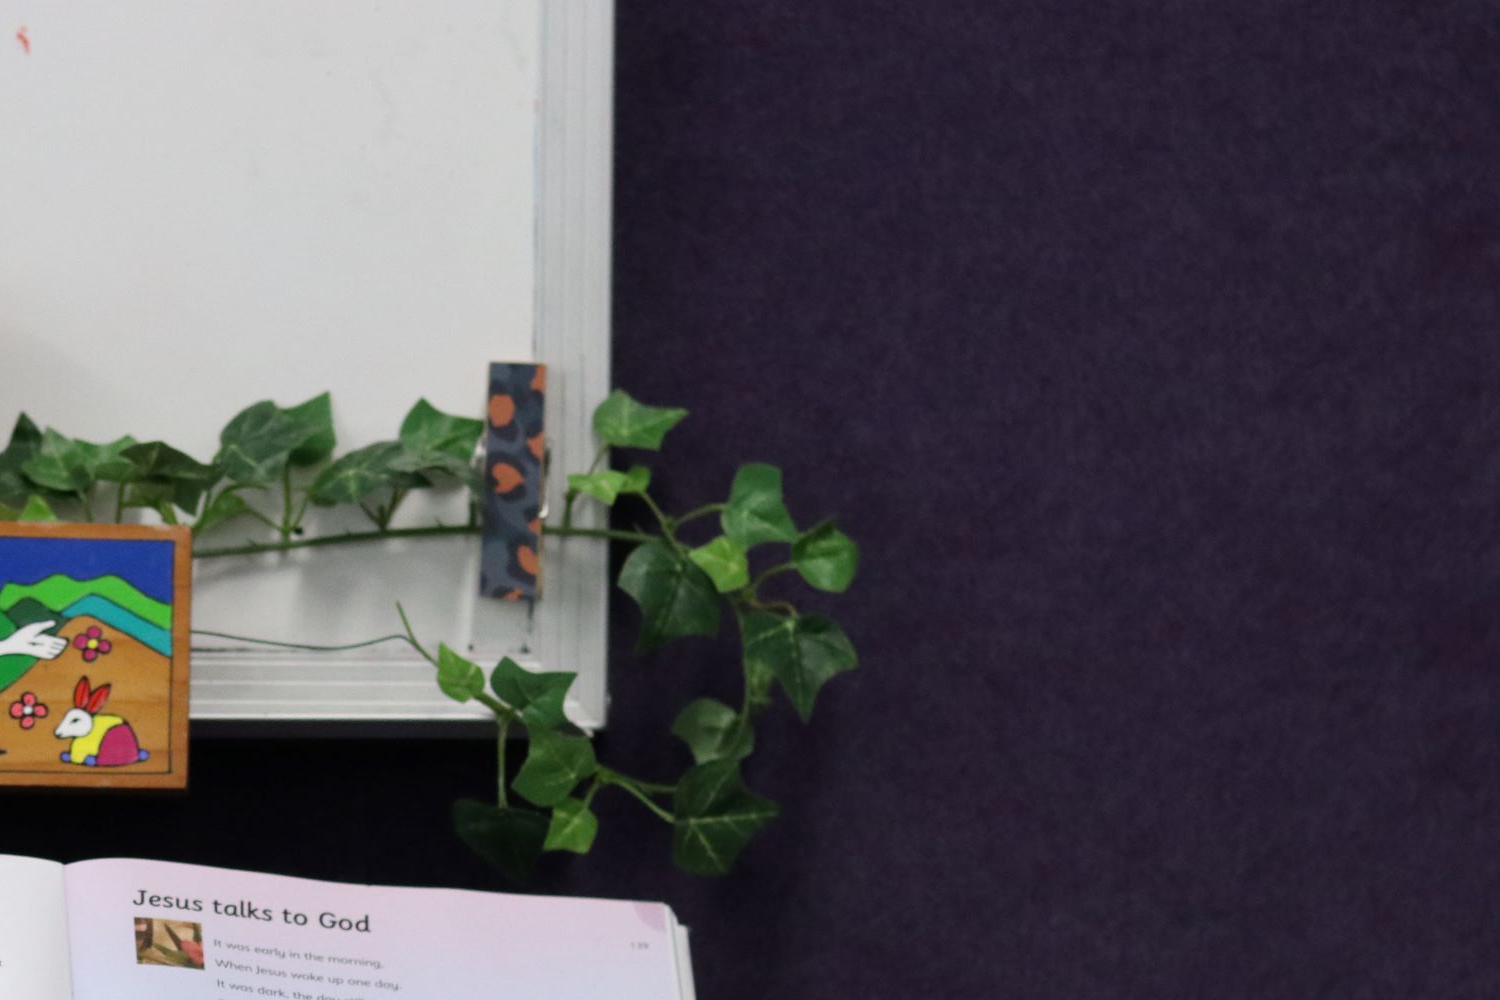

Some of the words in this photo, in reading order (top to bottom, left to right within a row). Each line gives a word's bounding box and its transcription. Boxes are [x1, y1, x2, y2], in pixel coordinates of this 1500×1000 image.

[132, 889, 203, 911] Jesus
[212, 899, 273, 921] talks
[281, 908, 308, 925] to
[318, 911, 370, 932] God
